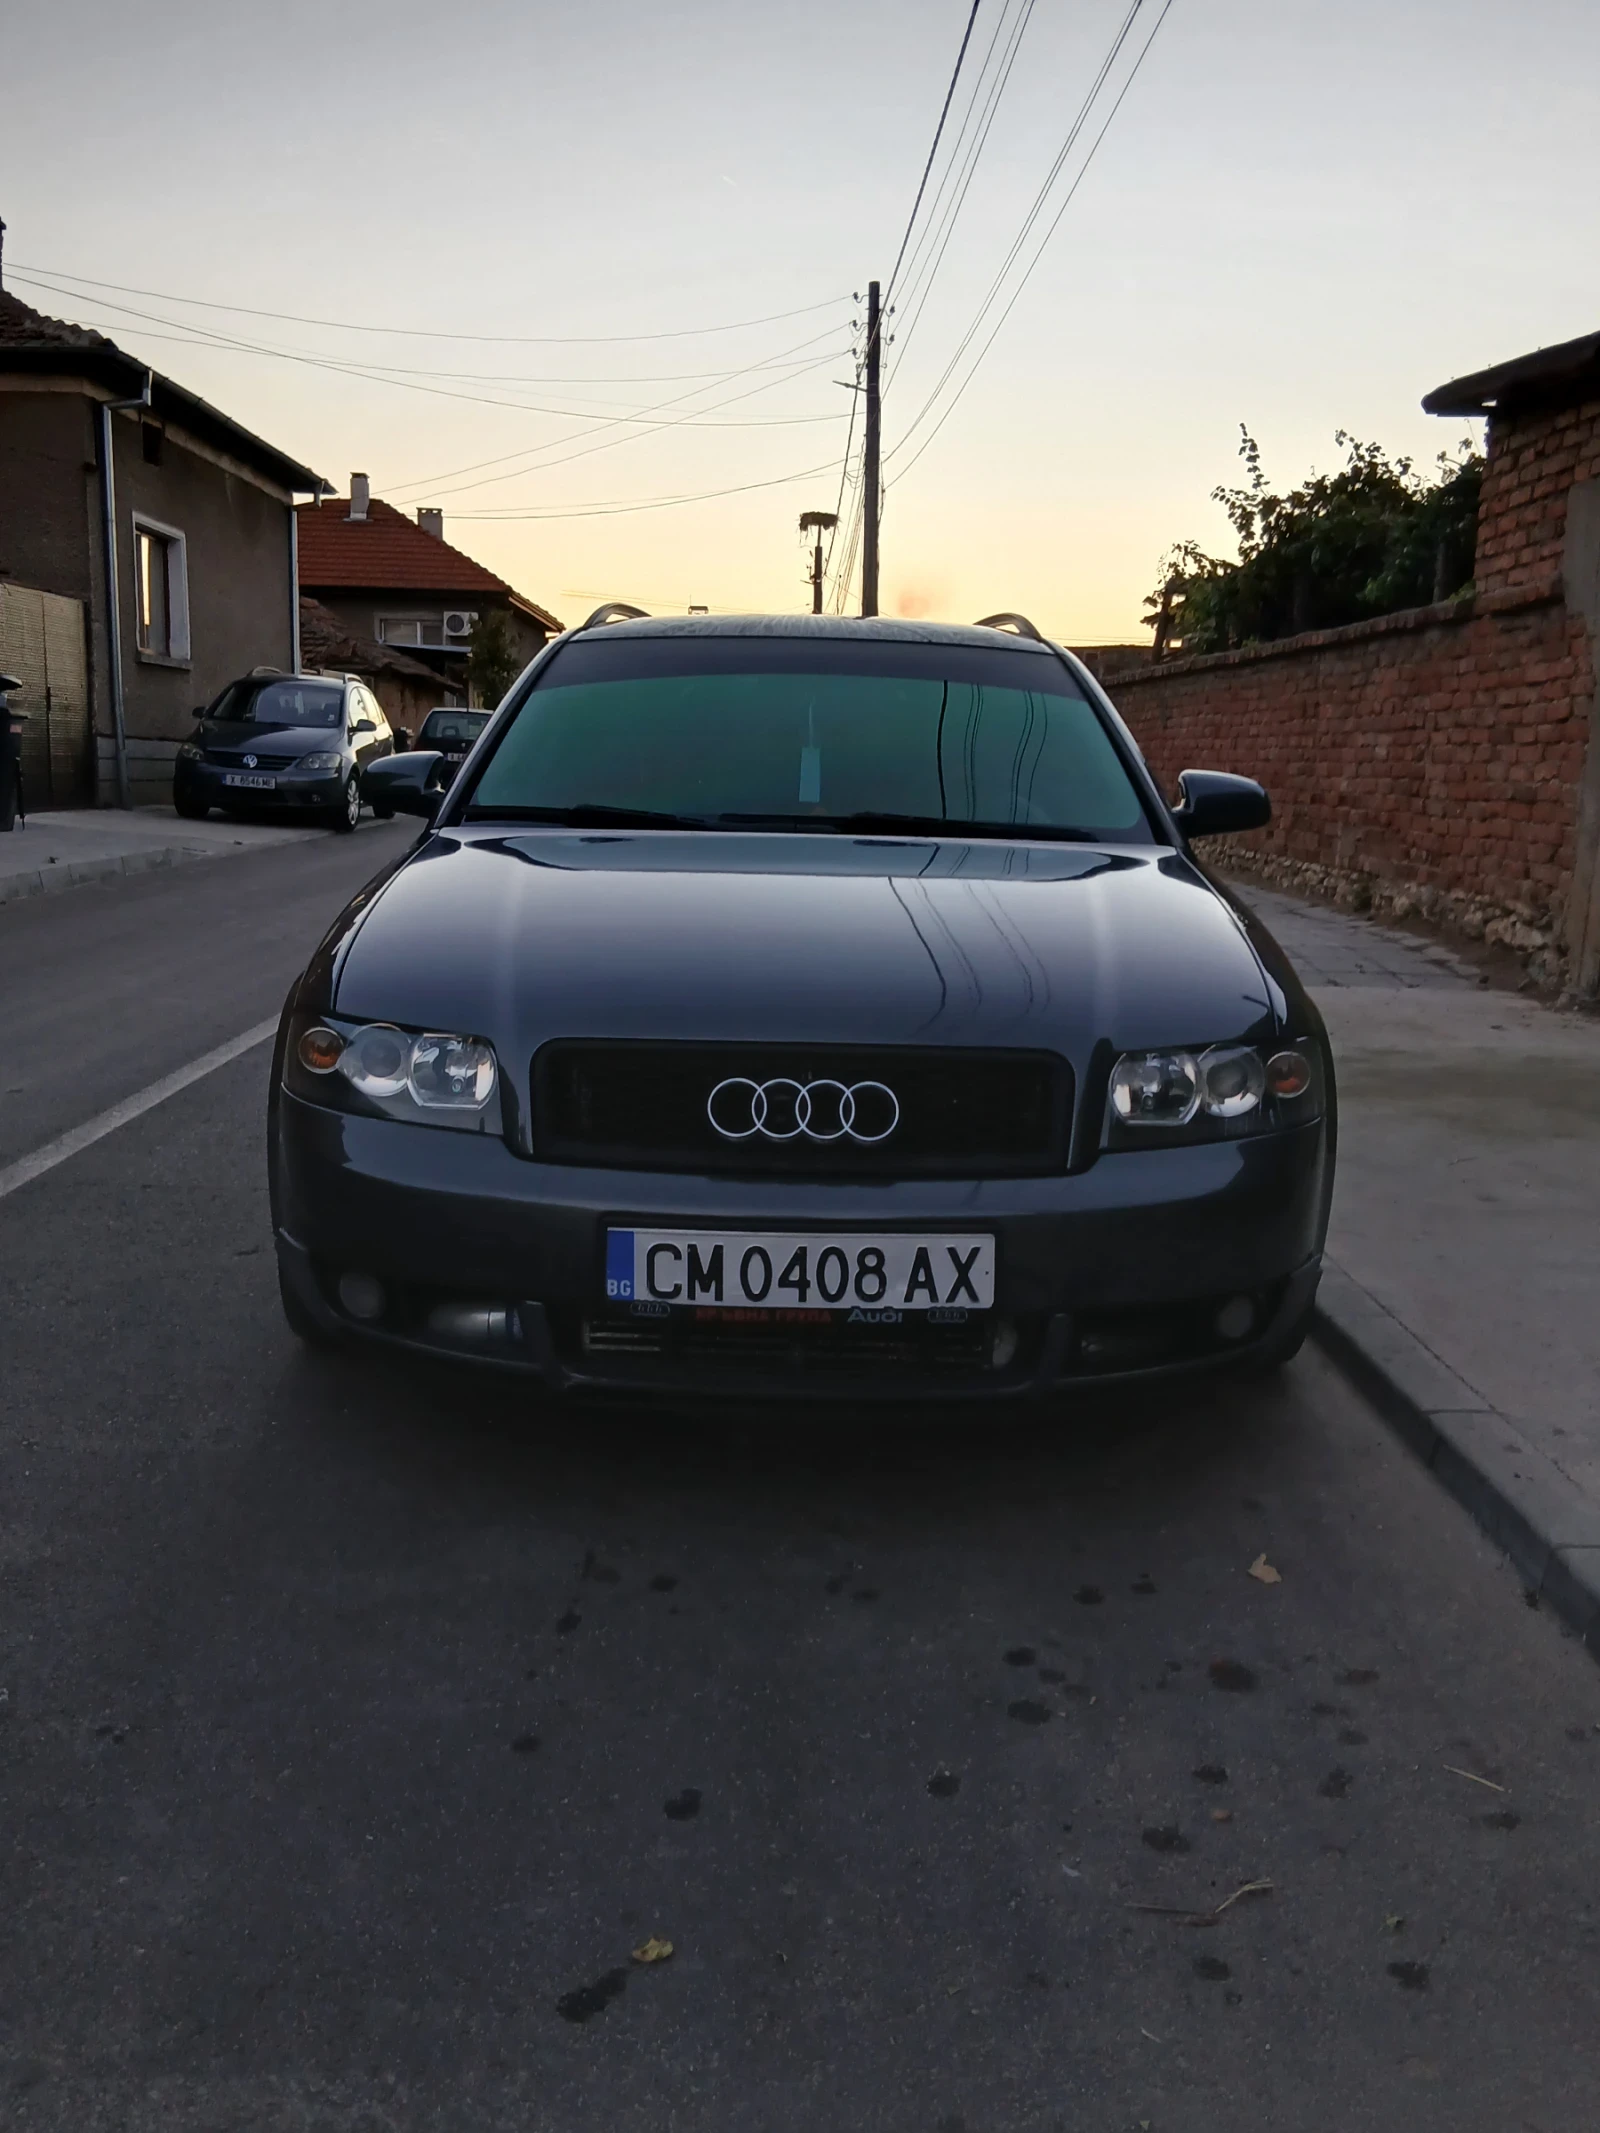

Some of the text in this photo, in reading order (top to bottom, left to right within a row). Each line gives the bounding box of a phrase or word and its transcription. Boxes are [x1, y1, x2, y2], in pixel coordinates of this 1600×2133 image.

[646, 1243, 980, 1303] CM 0408 AX
[607, 1279, 632, 1297] BG
[847, 1307, 903, 1323] Audi
